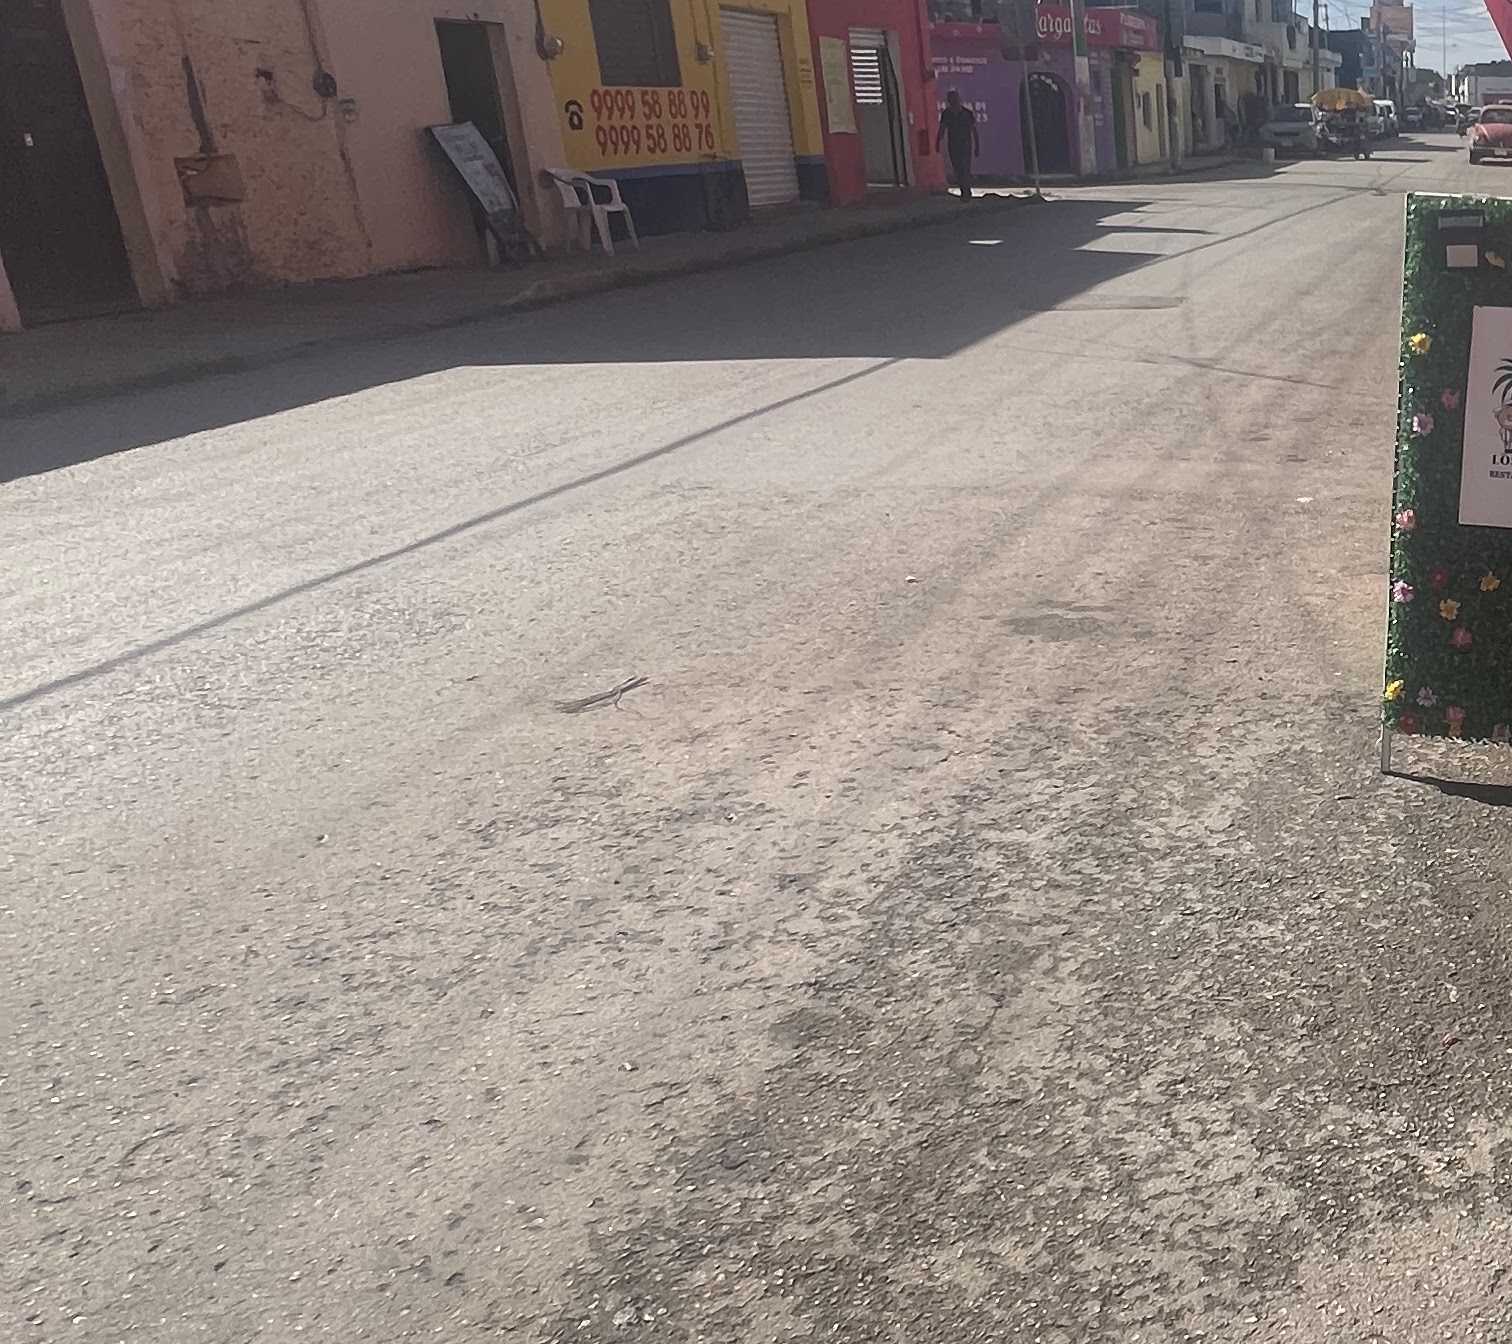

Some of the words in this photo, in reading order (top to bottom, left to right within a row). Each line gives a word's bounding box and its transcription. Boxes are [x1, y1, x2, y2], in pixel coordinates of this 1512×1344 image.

[590, 89, 635, 122] 9999
[641, 90, 662, 121] 58
[668, 90, 687, 119] 88
[690, 90, 710, 120] 99
[595, 124, 641, 156] 9999
[645, 123, 667, 154] 58
[672, 123, 692, 152] 88
[694, 122, 714, 151] 76
